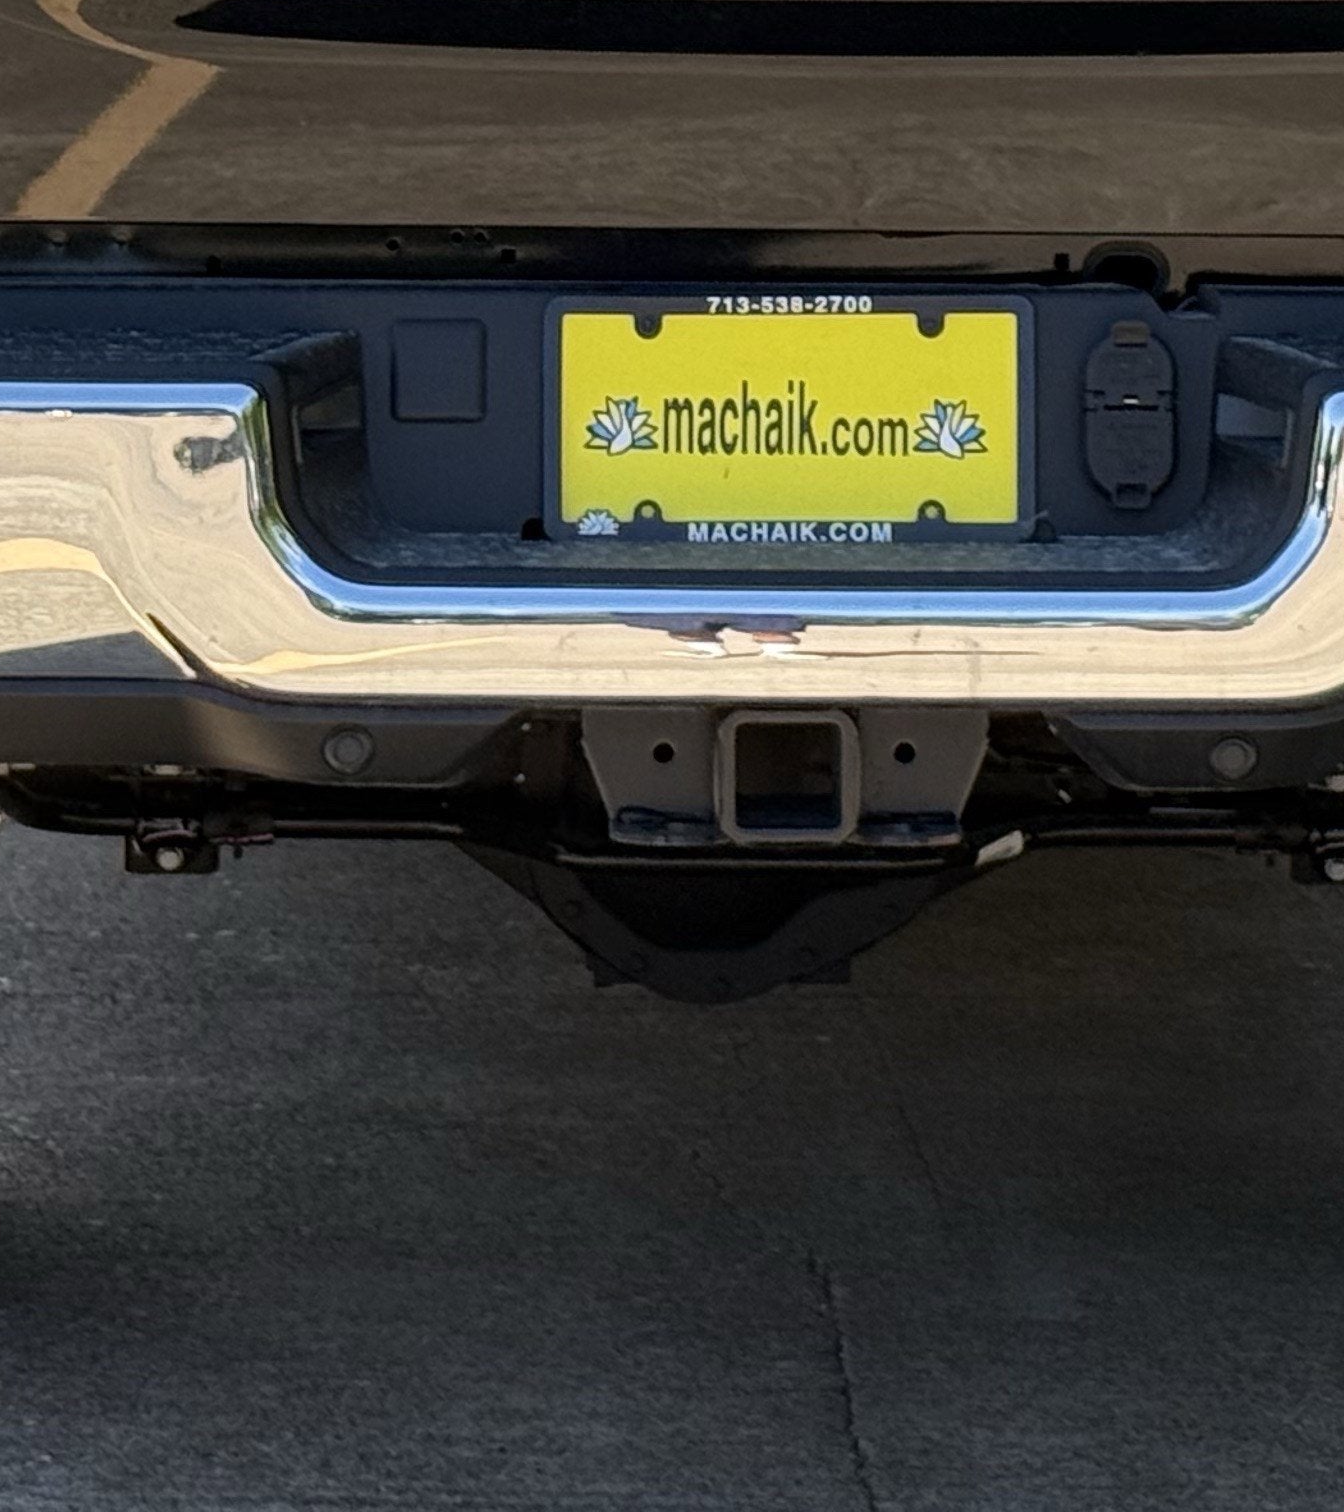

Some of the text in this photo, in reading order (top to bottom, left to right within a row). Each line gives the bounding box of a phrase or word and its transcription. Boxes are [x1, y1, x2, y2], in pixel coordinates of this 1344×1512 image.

[706, 296, 873, 314] 713-538-2700
[663, 381, 909, 456] machaik.com
[687, 521, 893, 543] MACHAIK.COM
